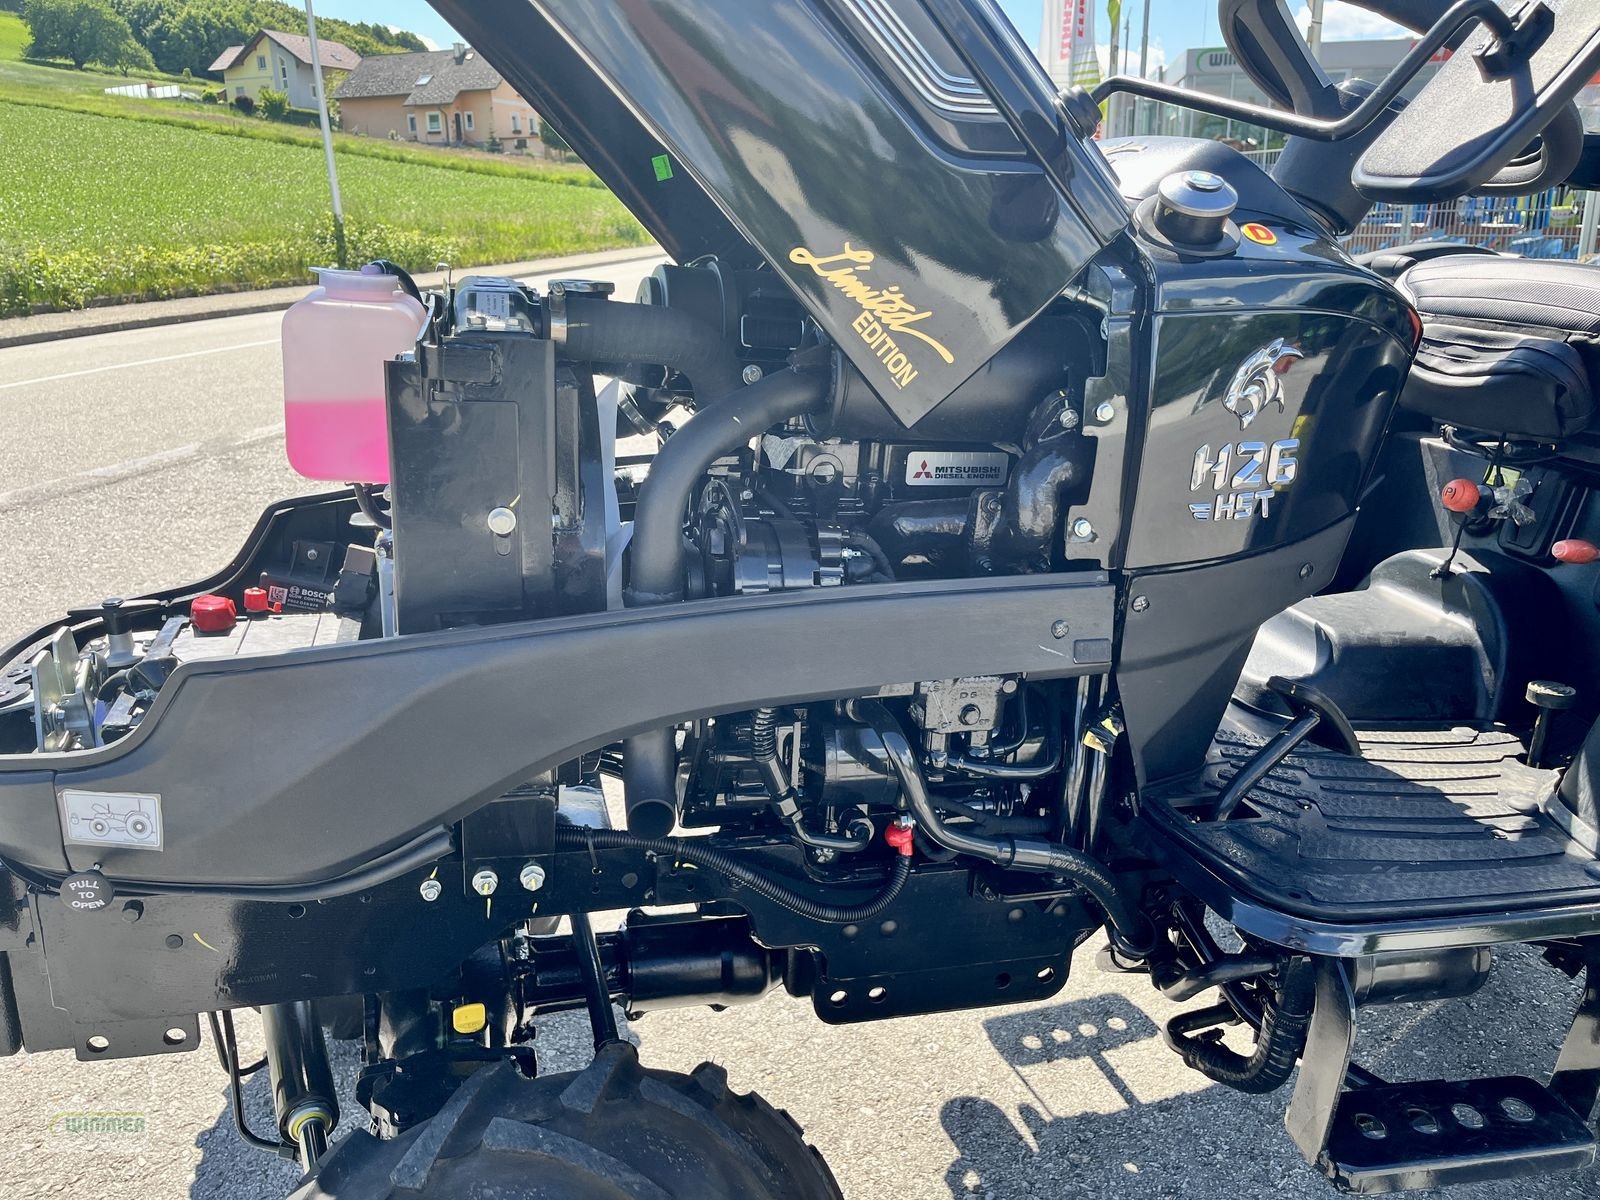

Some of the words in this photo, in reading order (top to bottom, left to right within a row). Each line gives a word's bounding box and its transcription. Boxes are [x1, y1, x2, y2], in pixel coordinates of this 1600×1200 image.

[789, 242, 954, 364] Limited
[852, 310, 919, 388] EDITION
[1189, 439, 1300, 491] H26
[1214, 489, 1275, 520] HST
[301, 588, 330, 600] BOSCH
[69, 880, 99, 890] PULL
[78, 891, 95, 899] TO
[71, 899, 105, 909] OPEN
